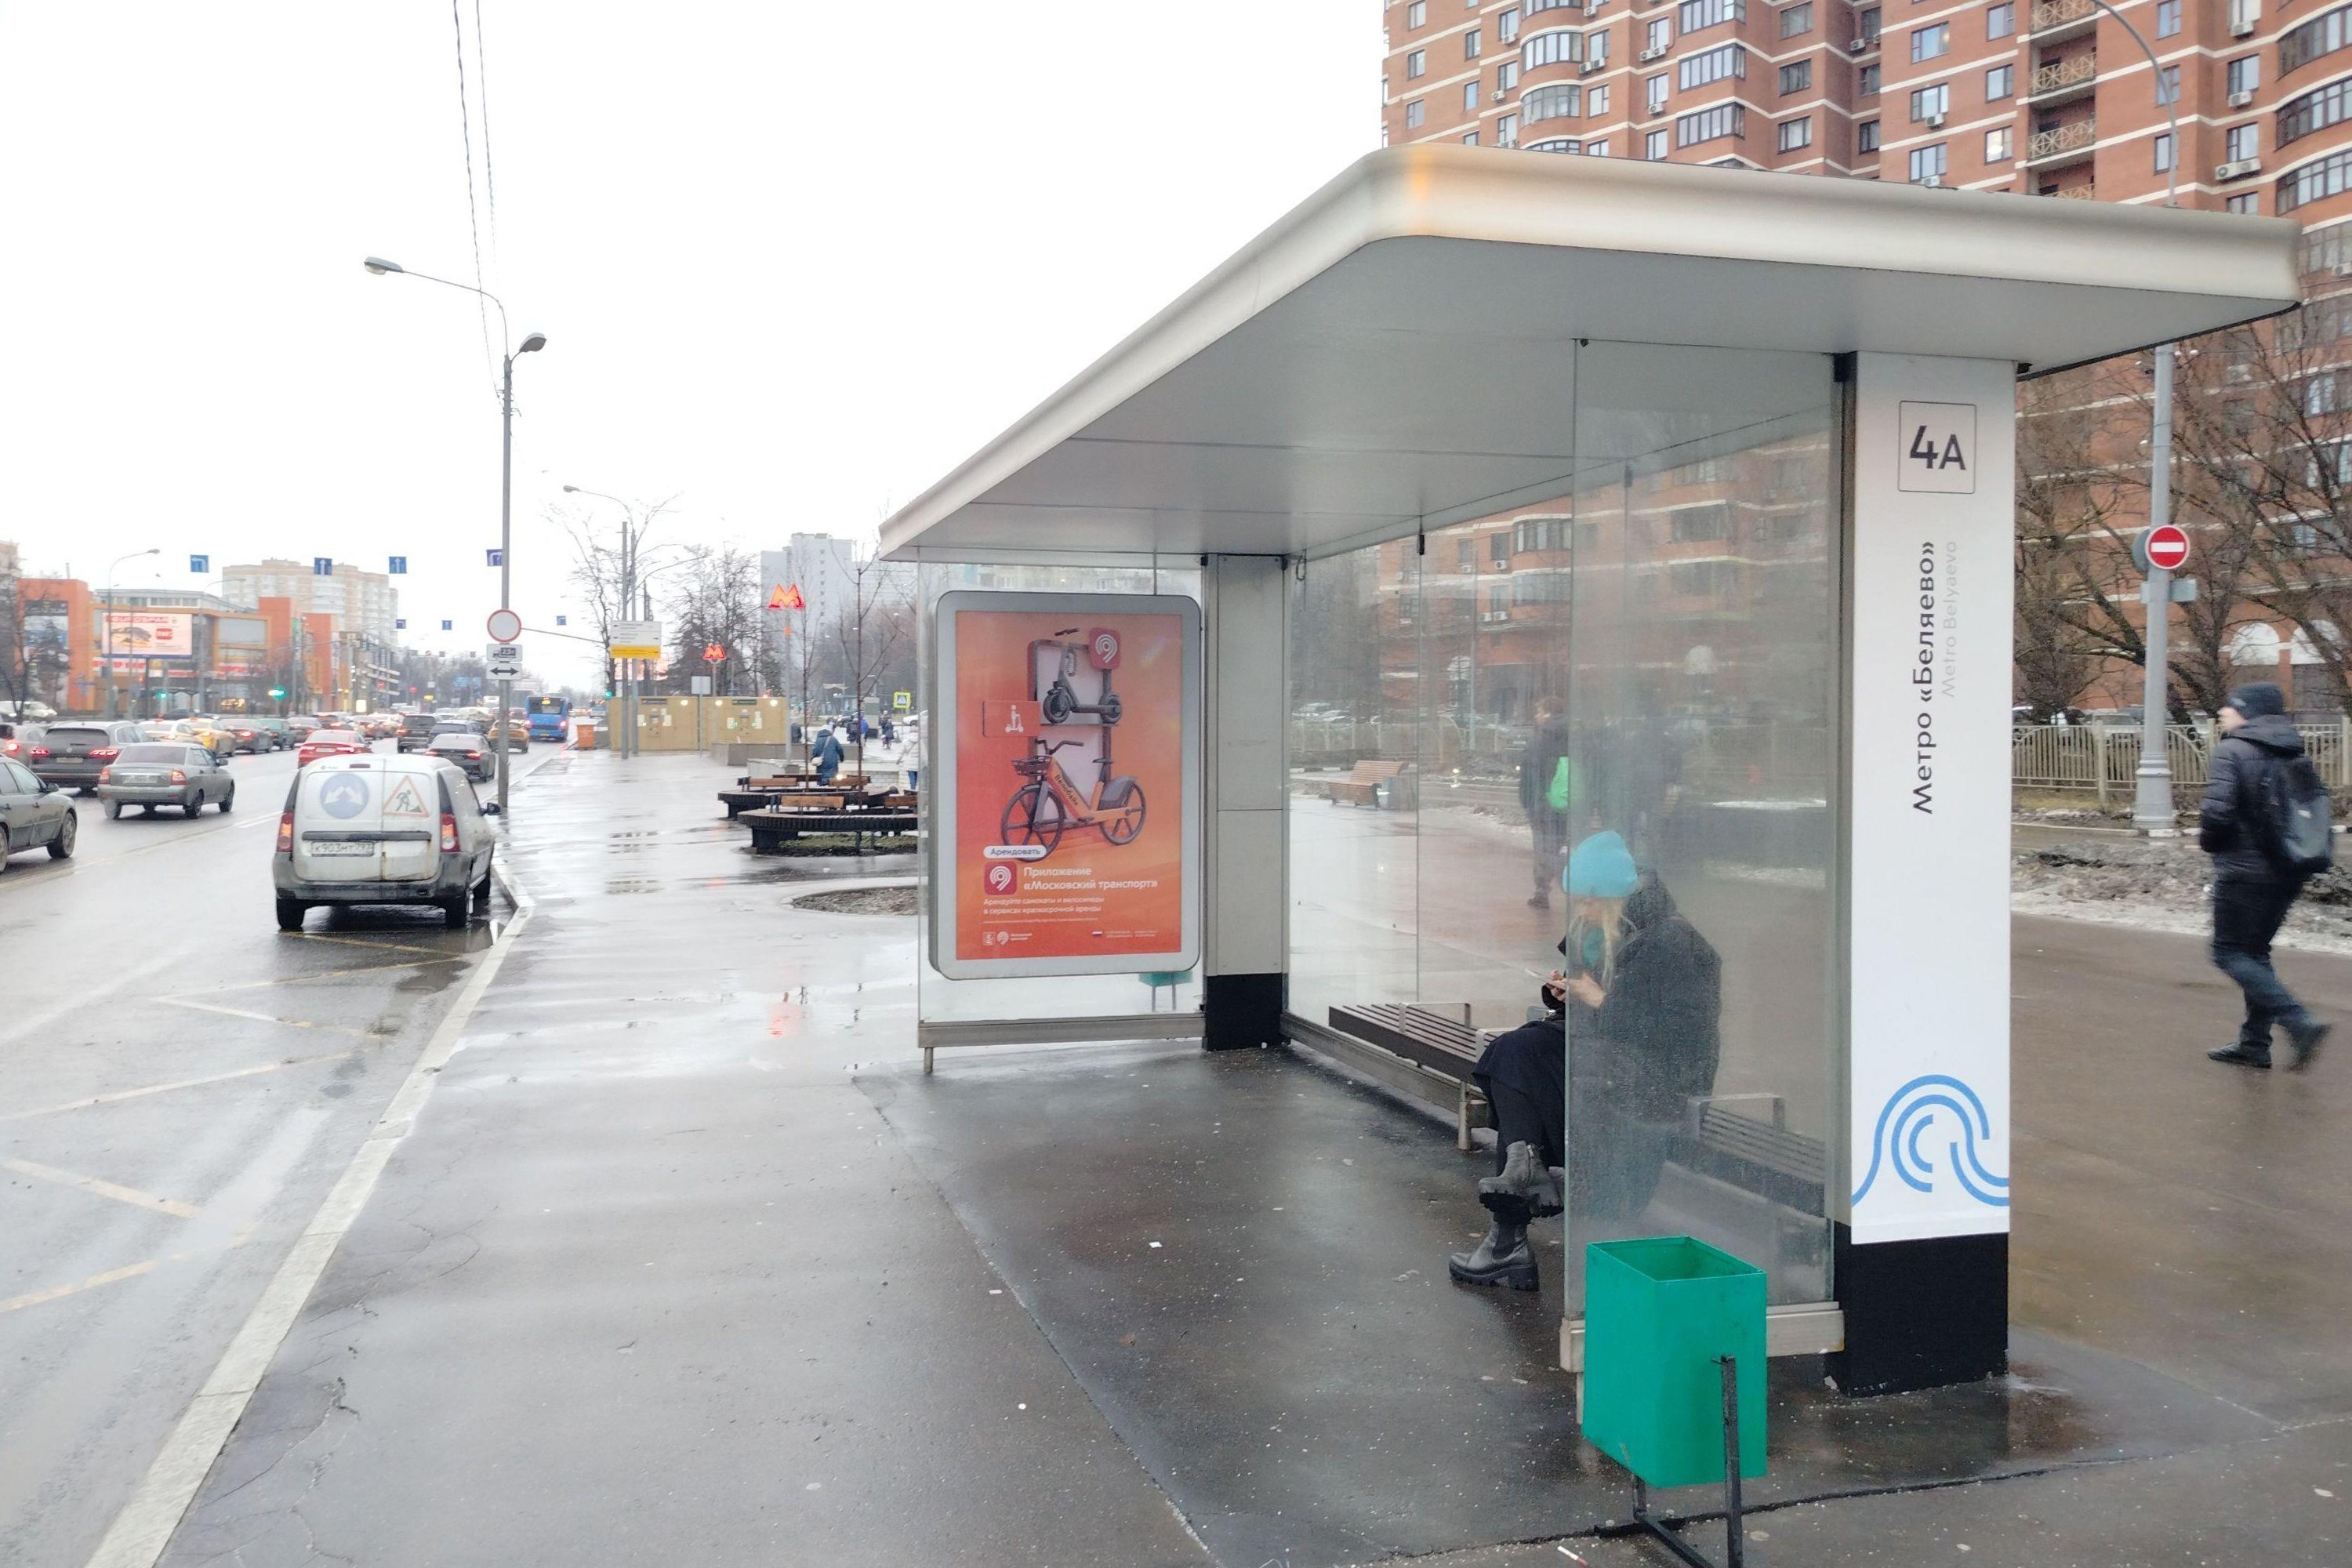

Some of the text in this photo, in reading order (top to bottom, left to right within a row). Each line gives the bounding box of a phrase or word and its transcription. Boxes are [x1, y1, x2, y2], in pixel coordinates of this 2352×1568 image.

[1941, 541, 1959, 698] Metro Belyaevo
[1912, 541, 1936, 815] Метро «Беляево»
[1023, 866, 1092, 877] Приложение
[1023, 880, 1158, 890] «Московский транспорт»
